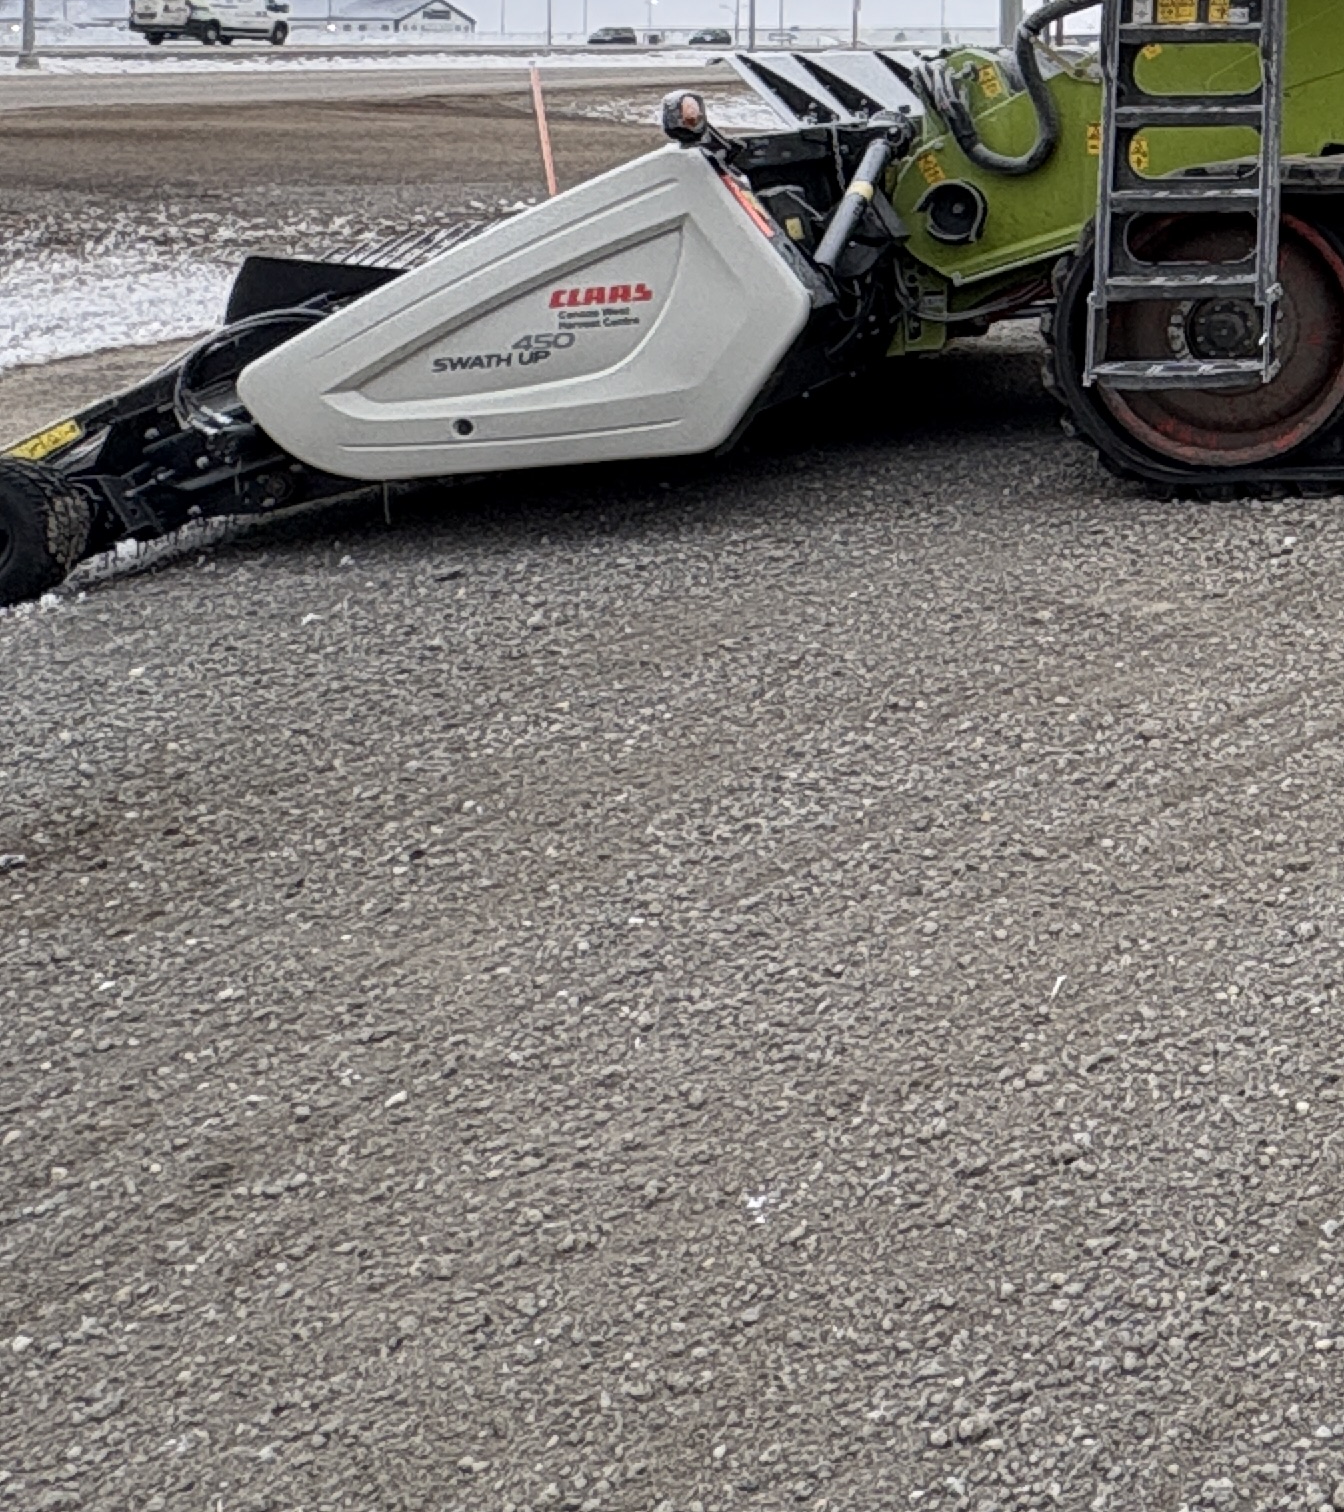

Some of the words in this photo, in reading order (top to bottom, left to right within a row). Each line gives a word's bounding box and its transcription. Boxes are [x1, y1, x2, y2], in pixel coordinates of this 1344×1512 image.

[549, 283, 653, 309] CLAAS
[512, 332, 576, 351] 450
[431, 351, 512, 373] SWATH
[518, 350, 551, 366] UP
